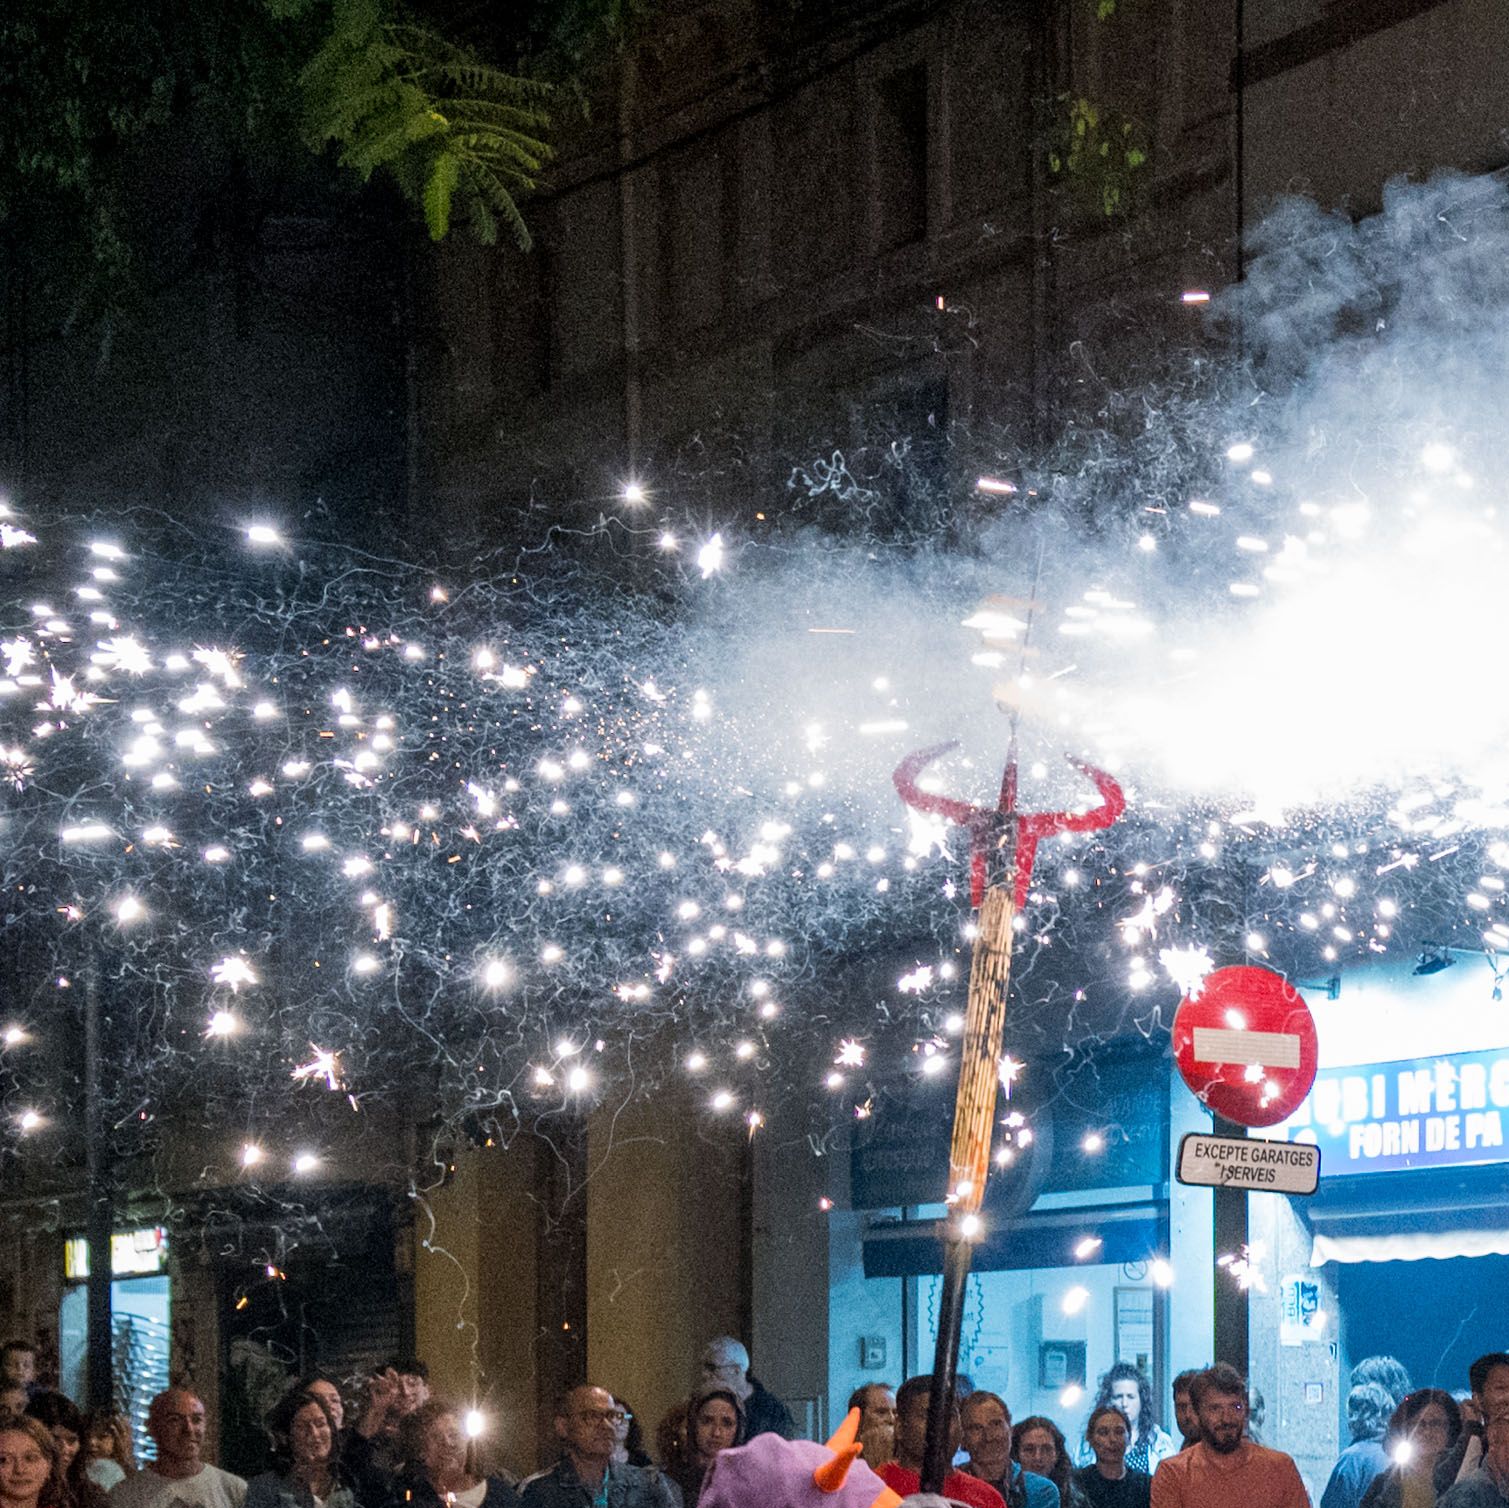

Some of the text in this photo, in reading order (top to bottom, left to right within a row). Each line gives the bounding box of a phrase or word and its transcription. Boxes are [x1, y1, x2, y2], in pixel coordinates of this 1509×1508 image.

[1350, 1110, 1503, 1159] FORN DE PA
[1195, 1143, 1313, 1167] EXCEPTE GARATGES
[1226, 1165, 1276, 1183] SERVEIS
